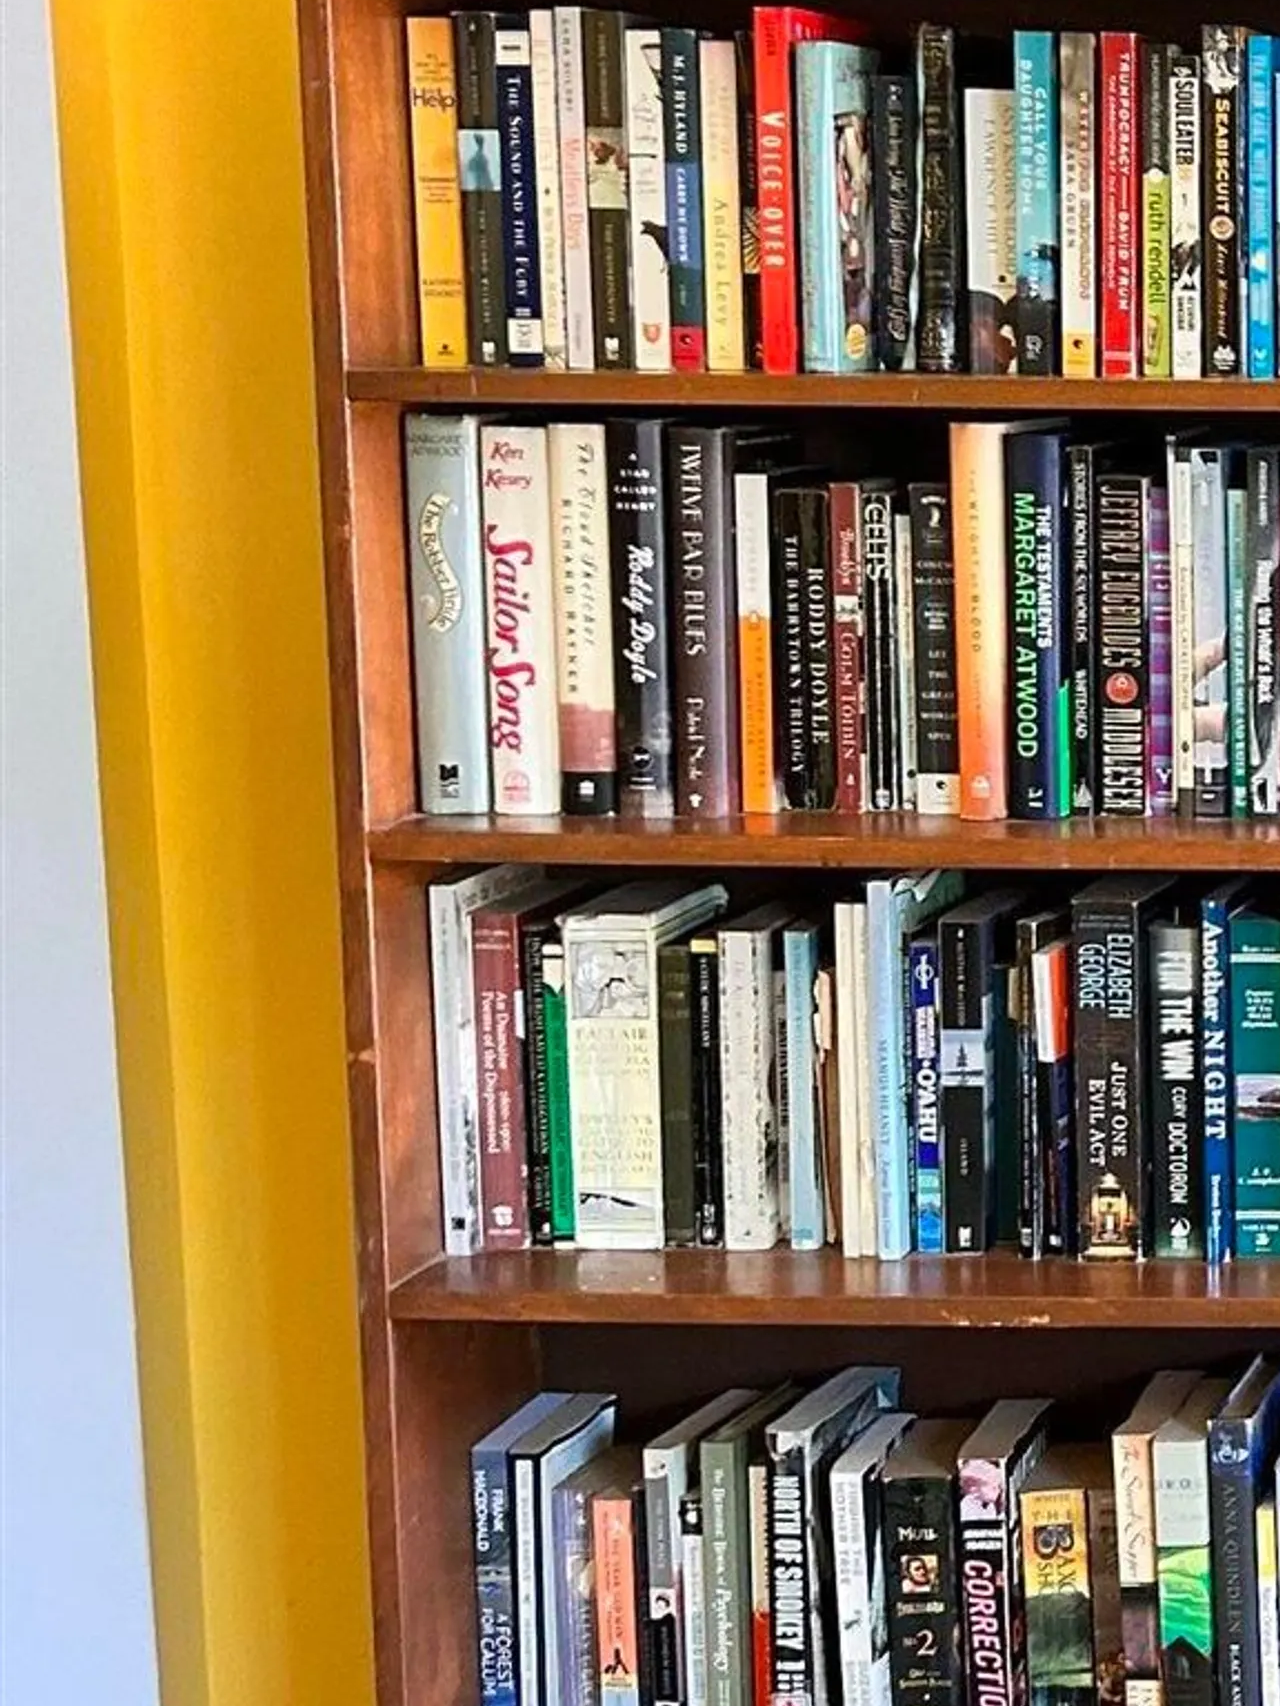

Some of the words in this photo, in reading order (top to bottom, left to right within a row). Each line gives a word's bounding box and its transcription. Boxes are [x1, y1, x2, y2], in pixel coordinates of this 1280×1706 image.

[506, 76, 522, 106] THE
[1175, 80, 1196, 118] SOUL
[508, 116, 525, 173] SOUND
[1175, 119, 1196, 166] EATER
[1215, 98, 1231, 213] SEABISCUIT
[511, 179, 524, 212] AND
[1148, 193, 1167, 233] ruth
[512, 220, 526, 248] THE
[713, 197, 731, 272] Andrea
[513, 257, 530, 298] FURY
[713, 280, 734, 327] Levy
[1148, 239, 1167, 304] rendell
[680, 444, 703, 522] TWELVE
[784, 536, 798, 569] THE
[865, 502, 888, 581] CELTS
[1036, 505, 1051, 536] THE
[1100, 486, 1143, 562] JEFFREY
[622, 545, 655, 618] Roddy
[682, 530, 704, 581] BAR
[1013, 493, 1036, 638] MARGARET
[486, 524, 535, 654] Sailor
[808, 568, 828, 652] RODDY
[1037, 543, 1052, 649] TESTAMENTS
[1101, 571, 1143, 668] EUGENIDES
[623, 620, 657, 684] Doyle
[683, 591, 706, 656] BLUES
[485, 648, 535, 754] Song
[810, 663, 830, 744] DOYLE
[1016, 646, 1038, 758] ATWOOD
[788, 696, 803, 774] TRILOGY
[1102, 706, 1143, 809] MIDDLESEX
[1079, 943, 1106, 1009] GEORGE
[1106, 933, 1133, 1019] ELIZABETH
[1159, 951, 1192, 992] FOR
[1202, 920, 1223, 1024] Another
[1160, 996, 1192, 1034] THE
[1110, 1061, 1127, 1111] JUST
[1161, 1039, 1193, 1081] WIN
[1205, 1029, 1225, 1140] NIGHT
[918, 1069, 936, 1144] O'AHU
[1089, 1079, 1106, 1124] EVIL
[1172, 1086, 1184, 1119] CORY
[1091, 1128, 1107, 1168] ACT
[1111, 1115, 1129, 1156] ONE
[771, 1475, 801, 1535] NORTH
[774, 1539, 801, 1564] OF
[775, 1568, 805, 1650] SMOKEY
